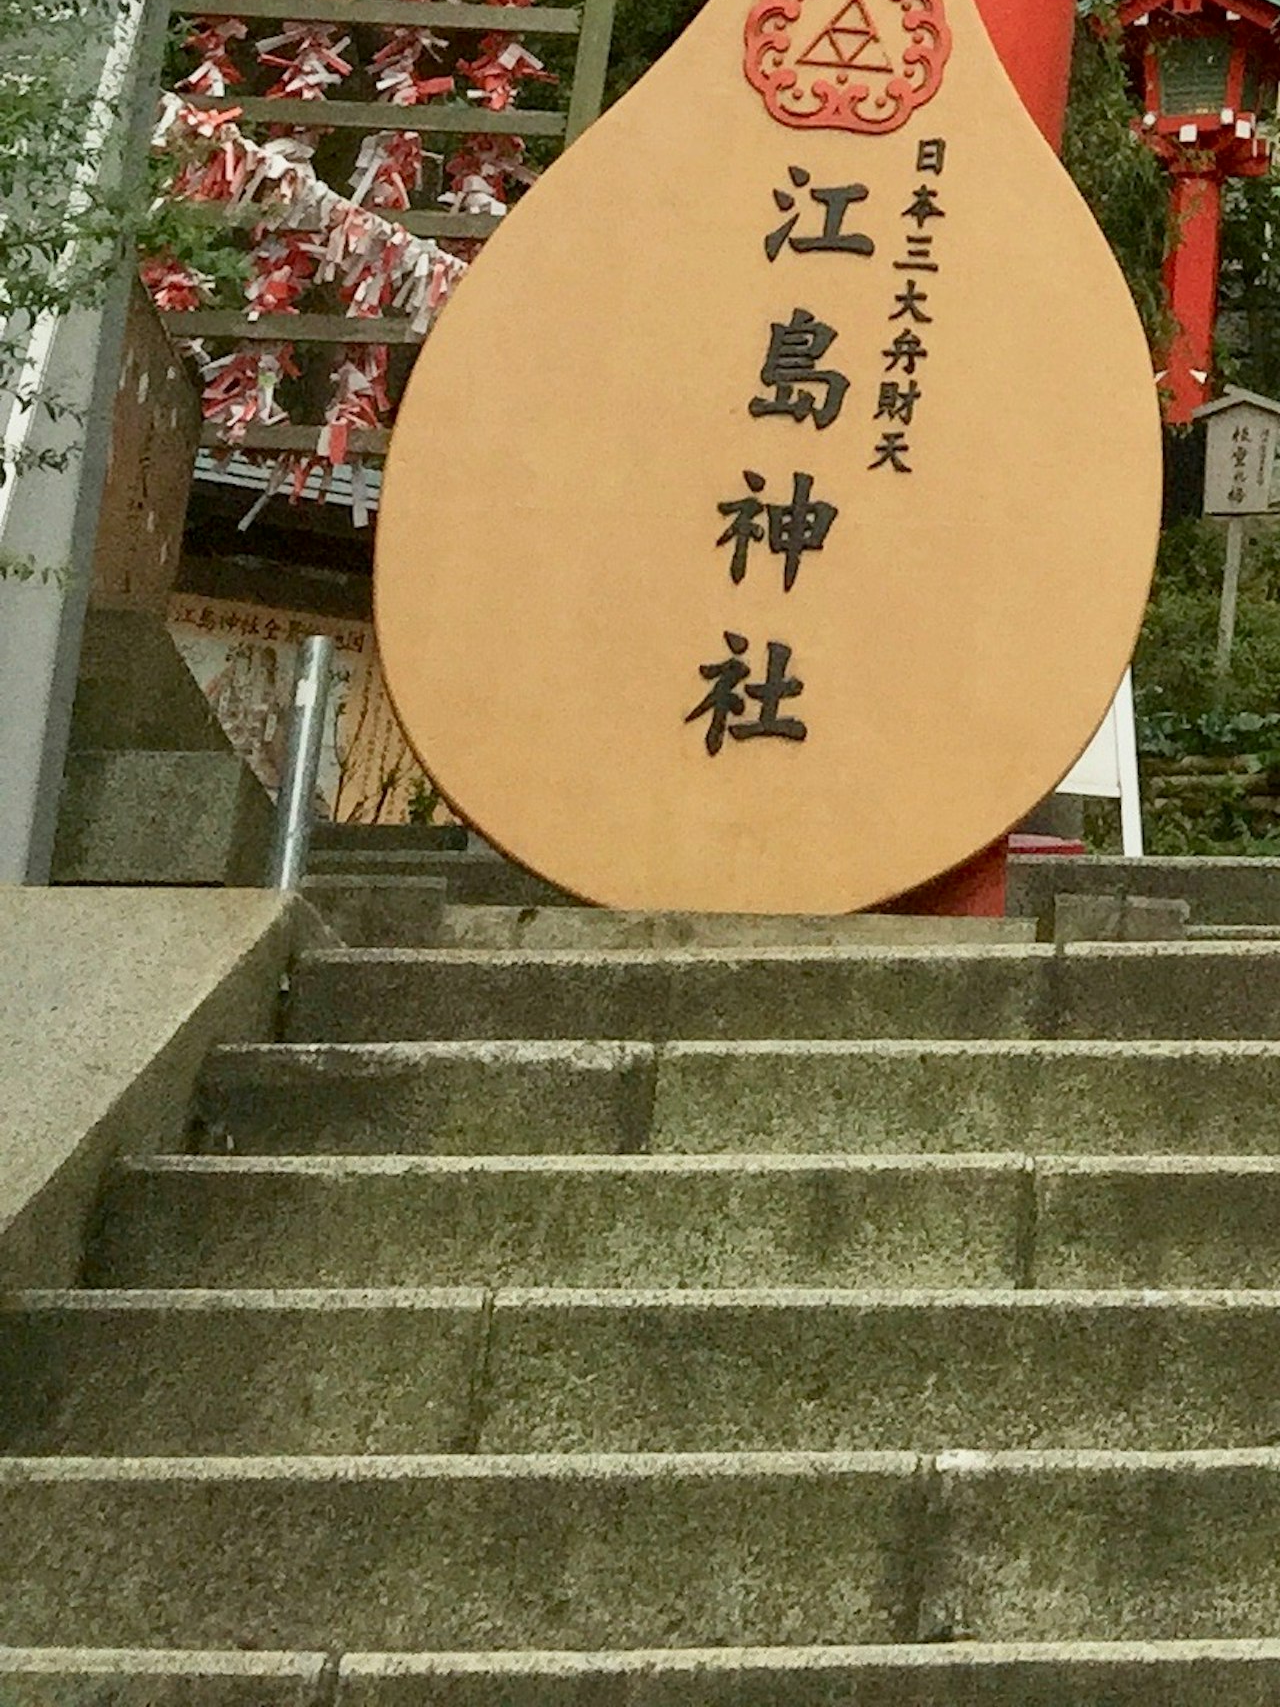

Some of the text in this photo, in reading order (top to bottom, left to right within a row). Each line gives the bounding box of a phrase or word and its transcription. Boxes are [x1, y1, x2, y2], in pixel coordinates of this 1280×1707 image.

[683, 164, 877, 758] 江島神社
[867, 137, 947, 475] 日本三大弁財天
